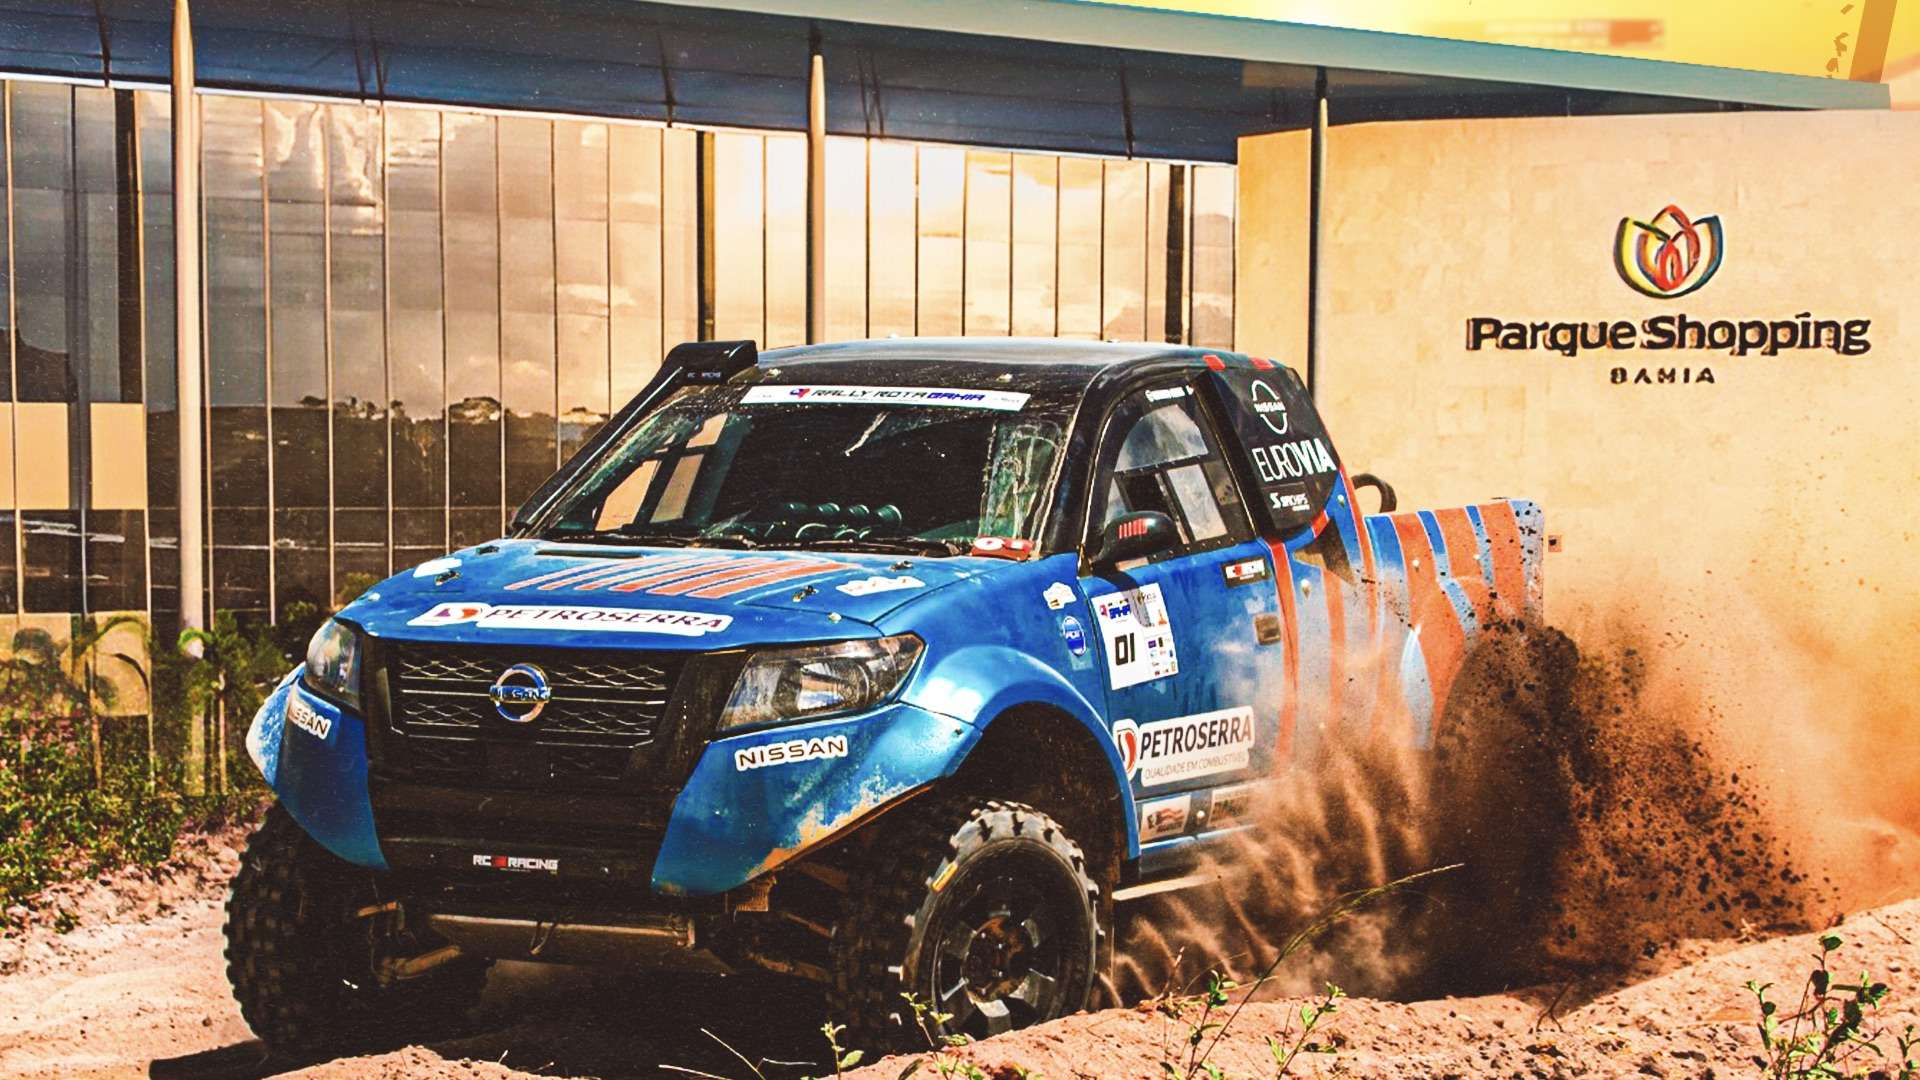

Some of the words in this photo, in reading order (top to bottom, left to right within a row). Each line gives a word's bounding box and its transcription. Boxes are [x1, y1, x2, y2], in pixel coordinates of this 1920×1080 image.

[811, 389, 872, 398] RALLY
[1252, 438, 1337, 482] EUROVIA
[485, 608, 726, 629] PETROSERRA
[1114, 632, 1136, 666] 01
[289, 703, 329, 736] SSAN
[1139, 714, 1252, 761] PETROSERRA
[739, 740, 844, 767] NISSAN
[508, 856, 559, 871] RACING
